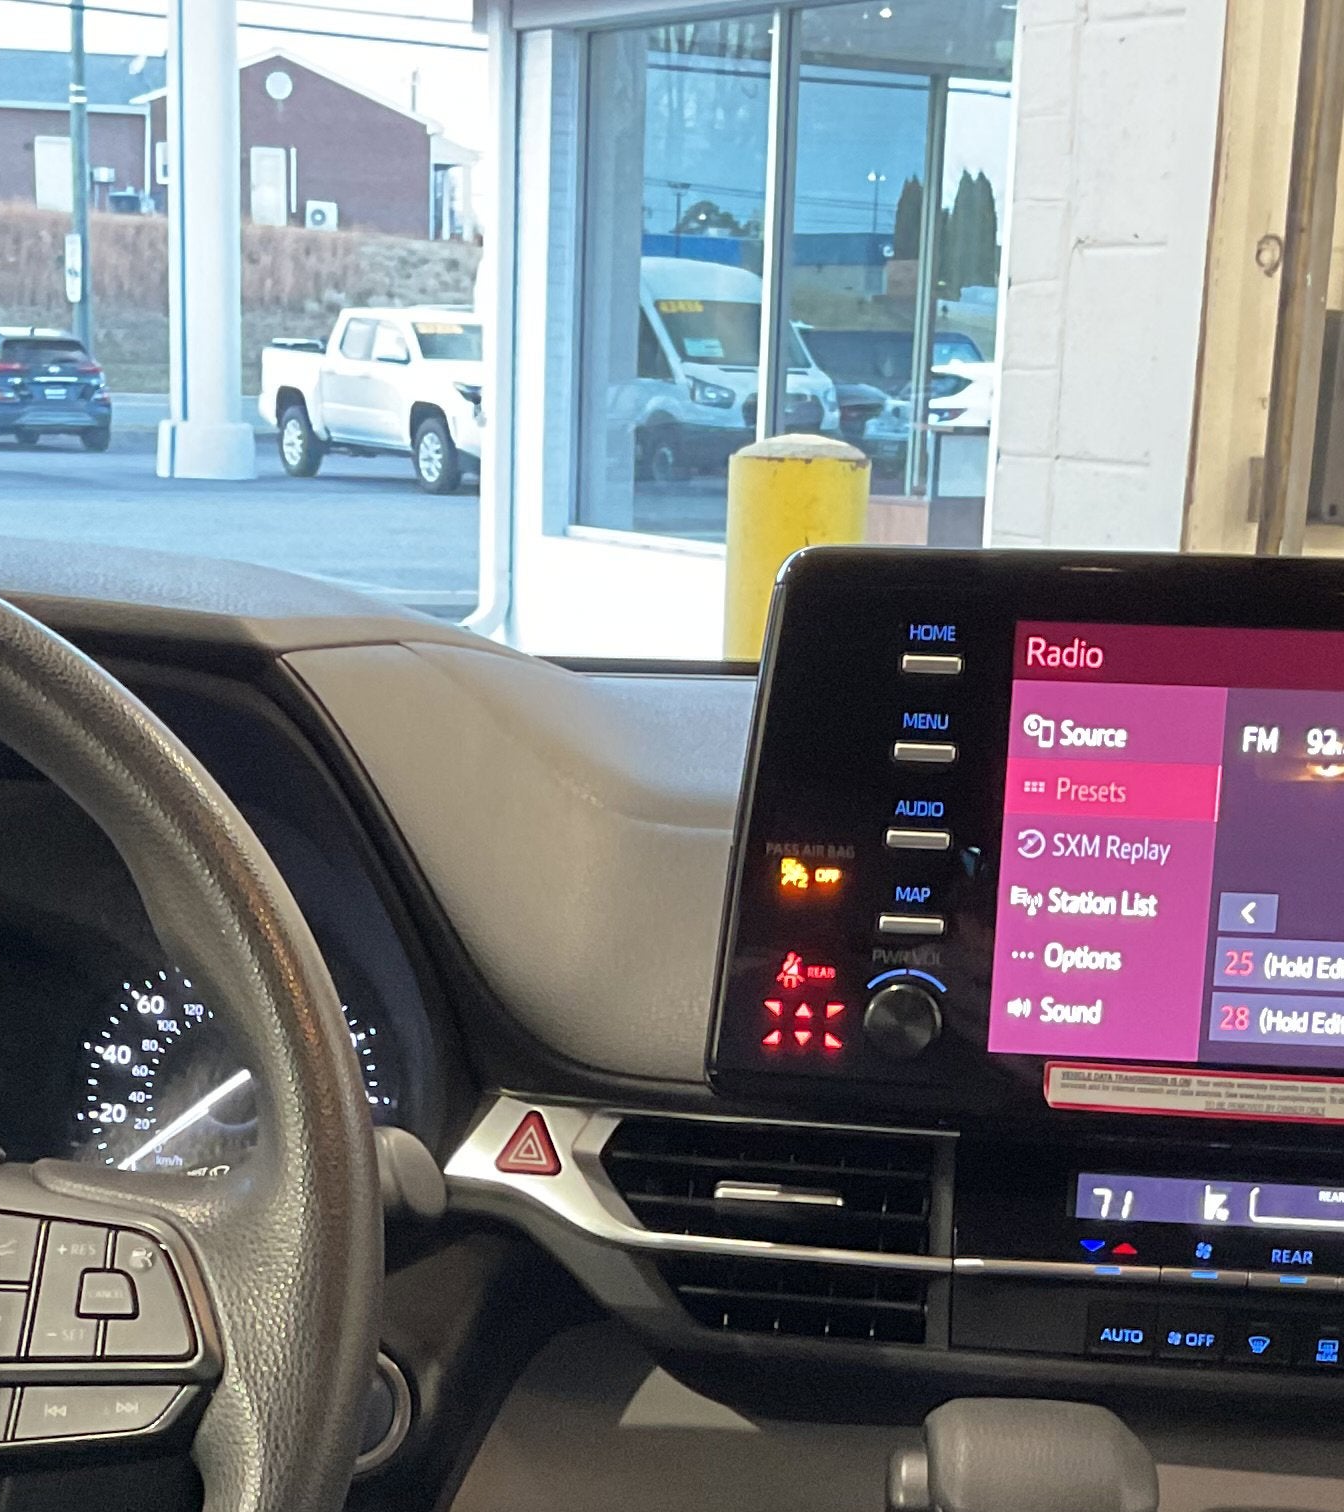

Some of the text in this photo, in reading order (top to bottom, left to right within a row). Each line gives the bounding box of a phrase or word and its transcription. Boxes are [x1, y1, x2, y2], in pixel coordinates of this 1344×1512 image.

[909, 624, 956, 643] HOME
[1025, 636, 1104, 670] Radio
[902, 712, 949, 731] MENU
[1059, 722, 1127, 751] Source
[1241, 727, 1279, 754] FM
[1056, 777, 1127, 804] Presets
[895, 800, 944, 819] AUDIO
[1051, 833, 1172, 866] SXM Replay
[895, 886, 931, 902] MAP
[1047, 890, 1158, 919] Station List
[1044, 943, 1122, 973] Options
[1223, 951, 1254, 977] 25
[1262, 953, 1309, 981] (Hold
[807, 965, 836, 979] REAR
[137, 995, 165, 1015] 60
[183, 1003, 204, 1017] 120
[1039, 997, 1102, 1026] Sound
[157, 1019, 177, 1032] 100
[1218, 1006, 1250, 1031] 28
[1259, 1007, 1306, 1036] (Hold
[141, 1039, 158, 1051] 80
[102, 1045, 131, 1065] 40
[131, 1065, 148, 1077] 60
[128, 1091, 145, 1103] 40
[99, 1103, 127, 1123] 20
[134, 1118, 150, 1130] 20
[1093, 1188, 1134, 1219] 71
[1271, 1249, 1313, 1266] REAR
[1100, 1327, 1144, 1344] AUTO
[1185, 1332, 1214, 1347] OFF
